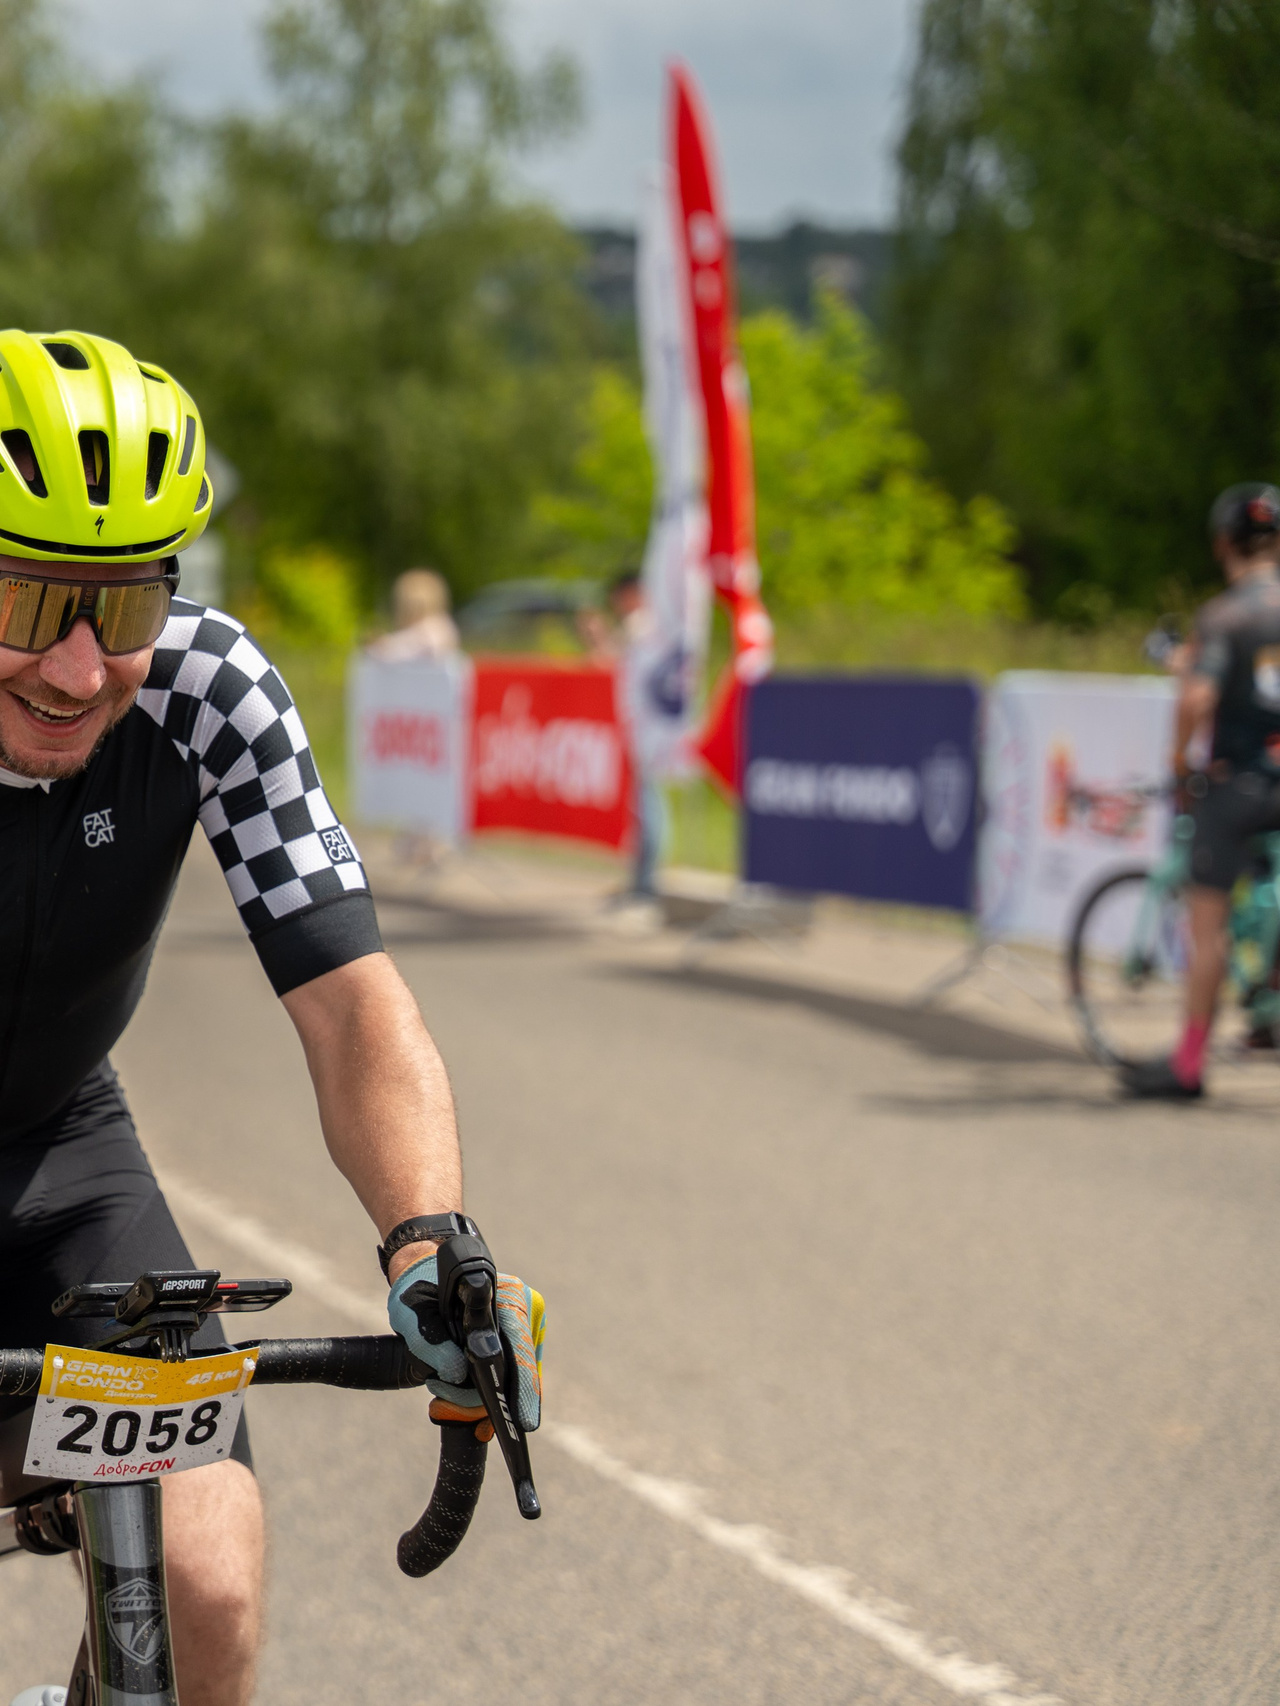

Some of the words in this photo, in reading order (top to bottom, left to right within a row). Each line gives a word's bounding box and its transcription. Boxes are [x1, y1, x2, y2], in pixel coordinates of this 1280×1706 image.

[83, 808, 112, 832] FAT
[85, 825, 116, 848] CAT
[321, 829, 344, 848] FAT
[328, 844, 352, 861] CAT
[162, 1279, 207, 1291] iGPSPORT
[66, 1360, 133, 1378] GRAN
[59, 1373, 145, 1391] FONDO
[495, 1391, 520, 1442] 105
[56, 1400, 222, 1457] 2058
